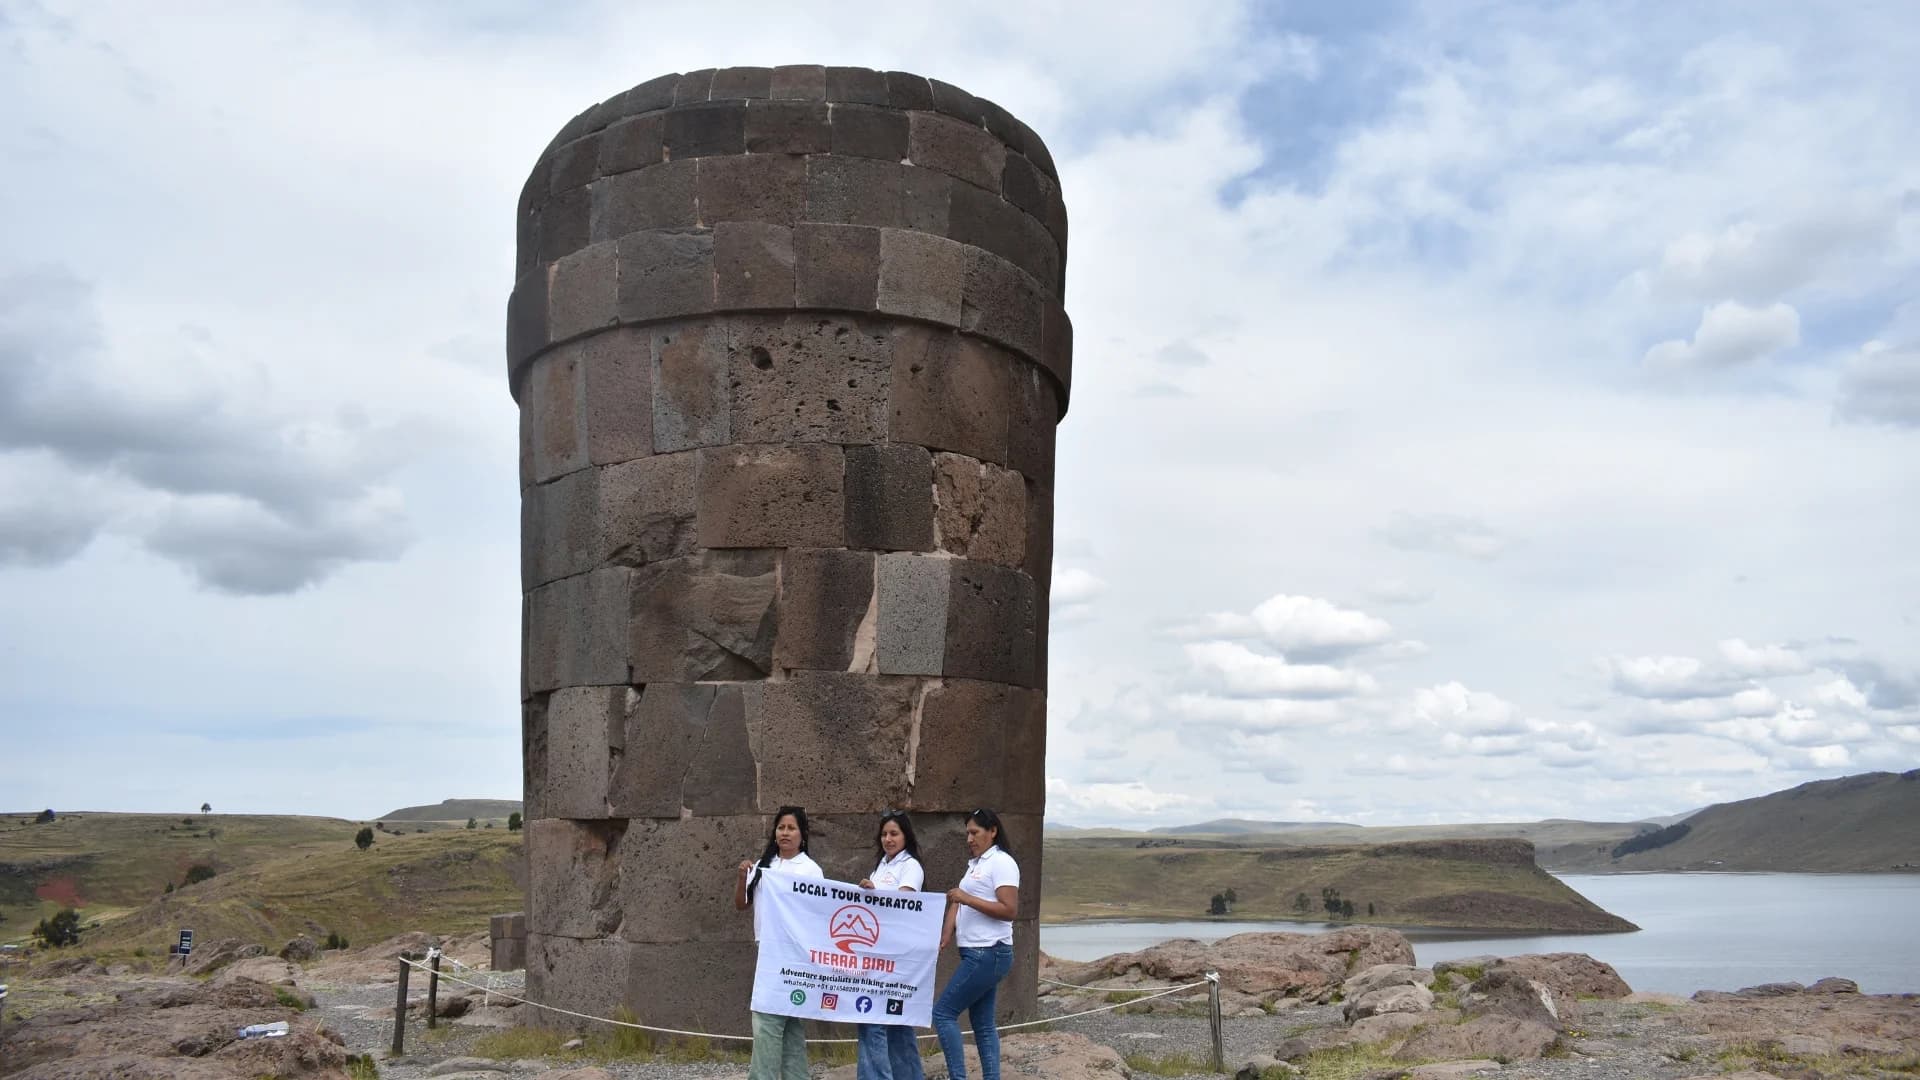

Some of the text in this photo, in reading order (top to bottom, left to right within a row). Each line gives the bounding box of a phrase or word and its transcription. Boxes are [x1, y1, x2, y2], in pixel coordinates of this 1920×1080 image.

[793, 882, 923, 912] LOCAL TOUR OPERATOR
[810, 950, 857, 968] TIERRA
[780, 968, 817, 980] Adventure
[819, 973, 852, 984] specialists
[853, 977, 860, 985] in
[861, 978, 884, 989] hiking
[900, 984, 918, 992] tours
